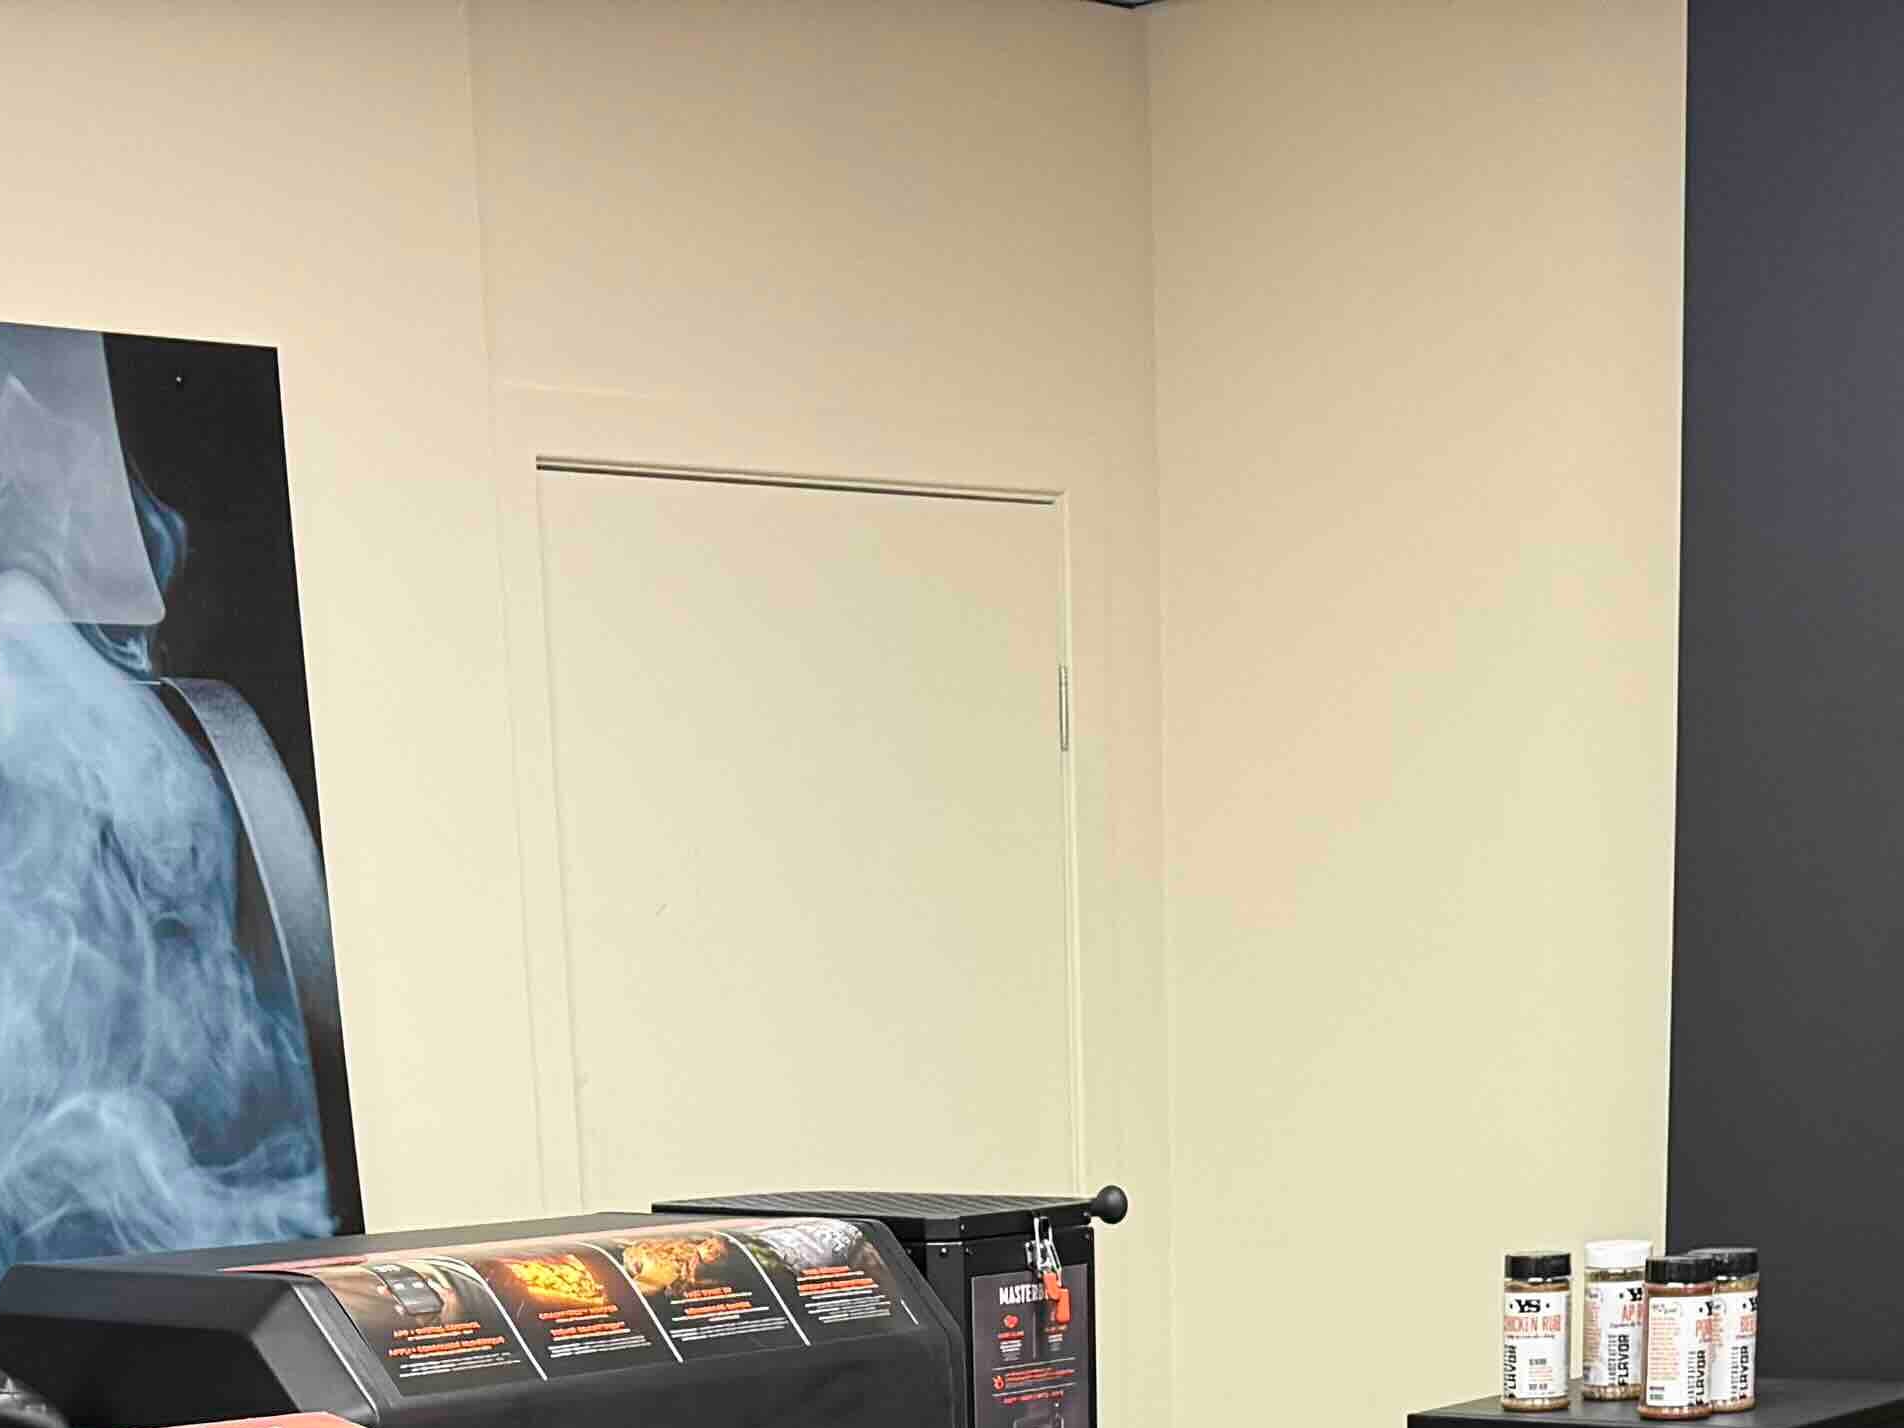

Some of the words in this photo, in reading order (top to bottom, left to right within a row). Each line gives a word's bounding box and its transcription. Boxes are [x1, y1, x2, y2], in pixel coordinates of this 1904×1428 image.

[999, 1283, 1045, 1305] MASTERB
[1515, 1299, 1541, 1313] YS
[1618, 1334, 1630, 1386] FLAVOR
